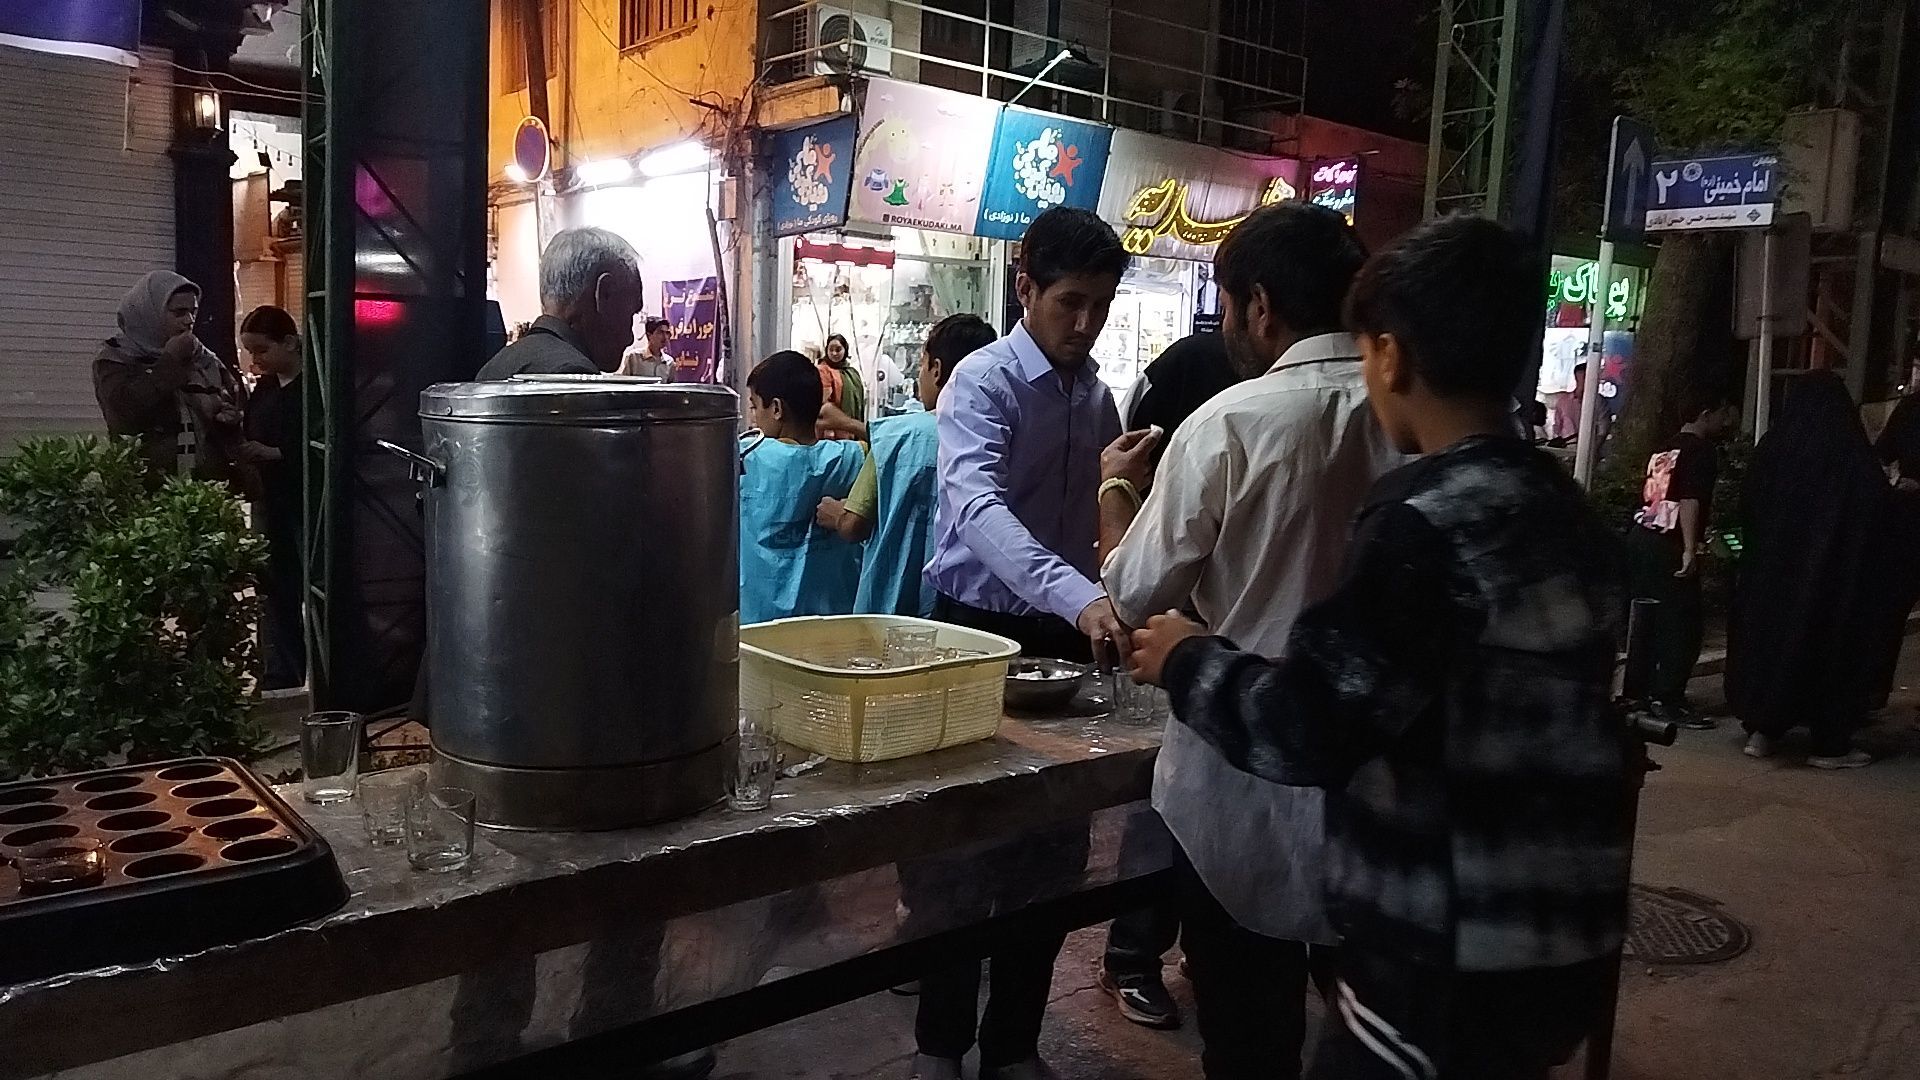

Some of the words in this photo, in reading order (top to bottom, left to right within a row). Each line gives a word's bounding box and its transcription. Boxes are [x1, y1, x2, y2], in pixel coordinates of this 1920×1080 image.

[1655, 169, 1678, 204] ۲
[1703, 171, 1742, 204] خمینی
[1741, 170, 1770, 205] امام
